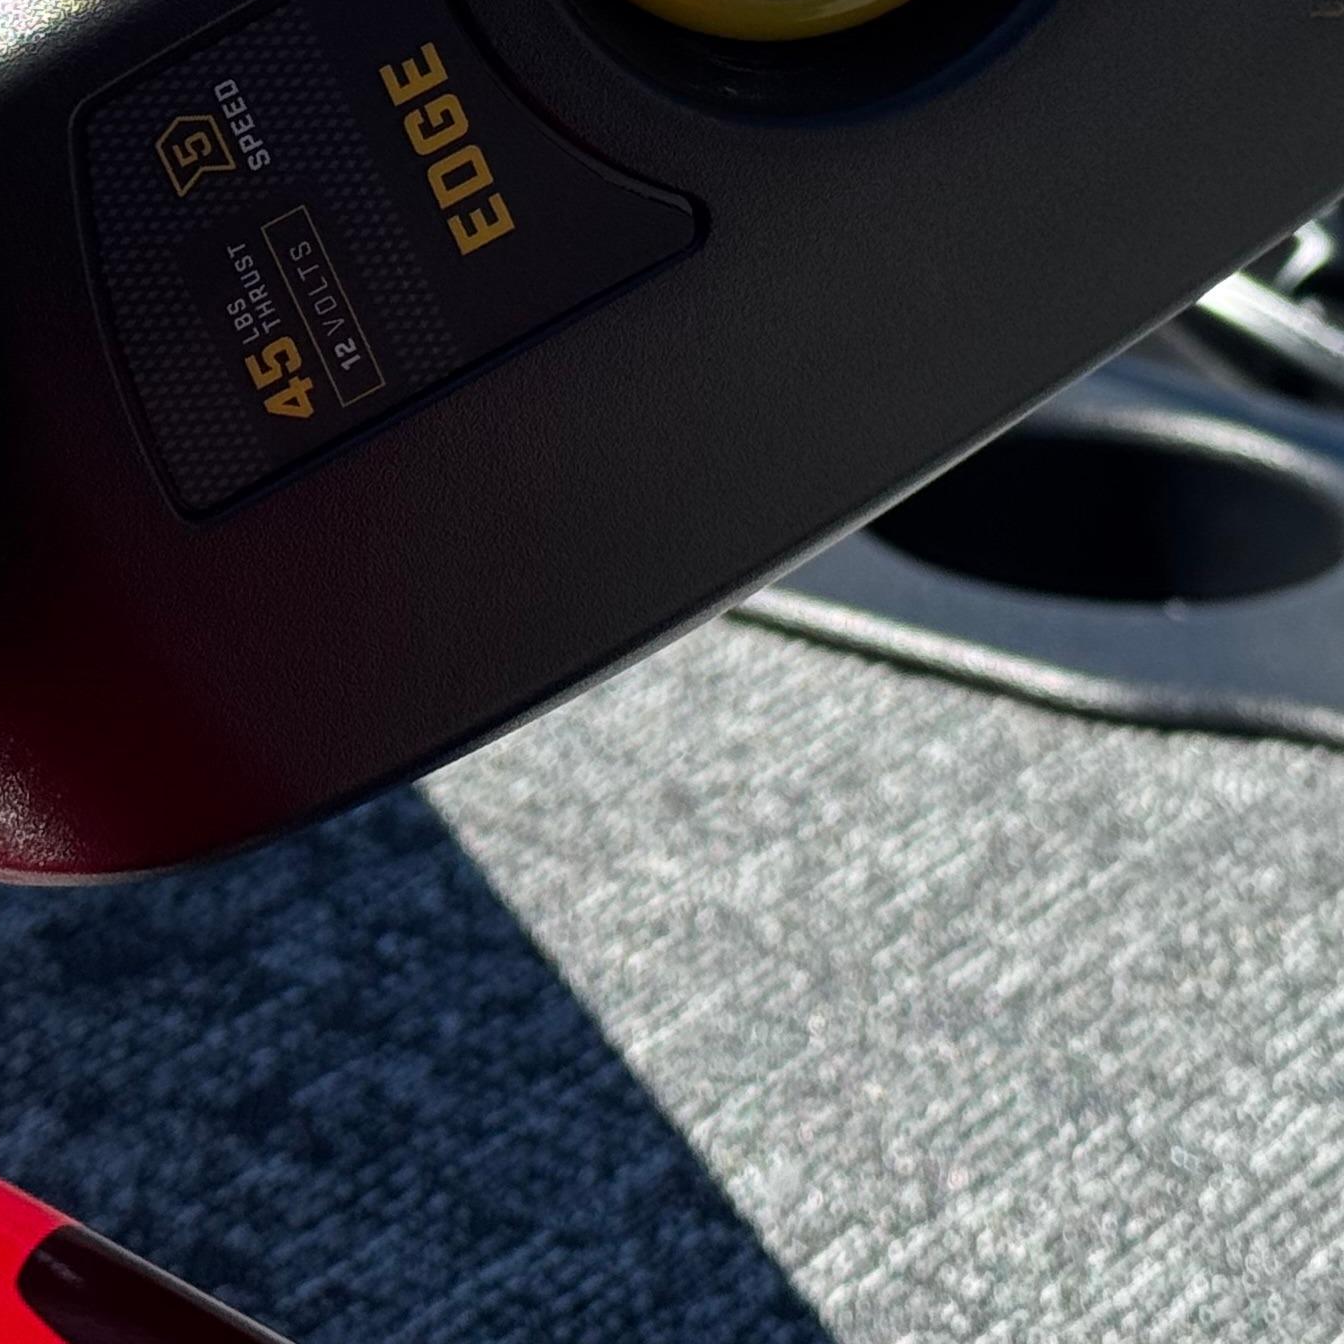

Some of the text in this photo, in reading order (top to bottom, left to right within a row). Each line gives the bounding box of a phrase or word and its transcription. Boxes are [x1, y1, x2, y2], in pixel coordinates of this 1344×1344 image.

[172, 132, 213, 166] 5
[215, 79, 270, 171] SPEED
[379, 42, 515, 255] EDGE
[227, 243, 281, 334] THRUST
[227, 298, 258, 346] LBS
[290, 241, 361, 371] 12 VOLTS
[245, 337, 314, 418] 45
